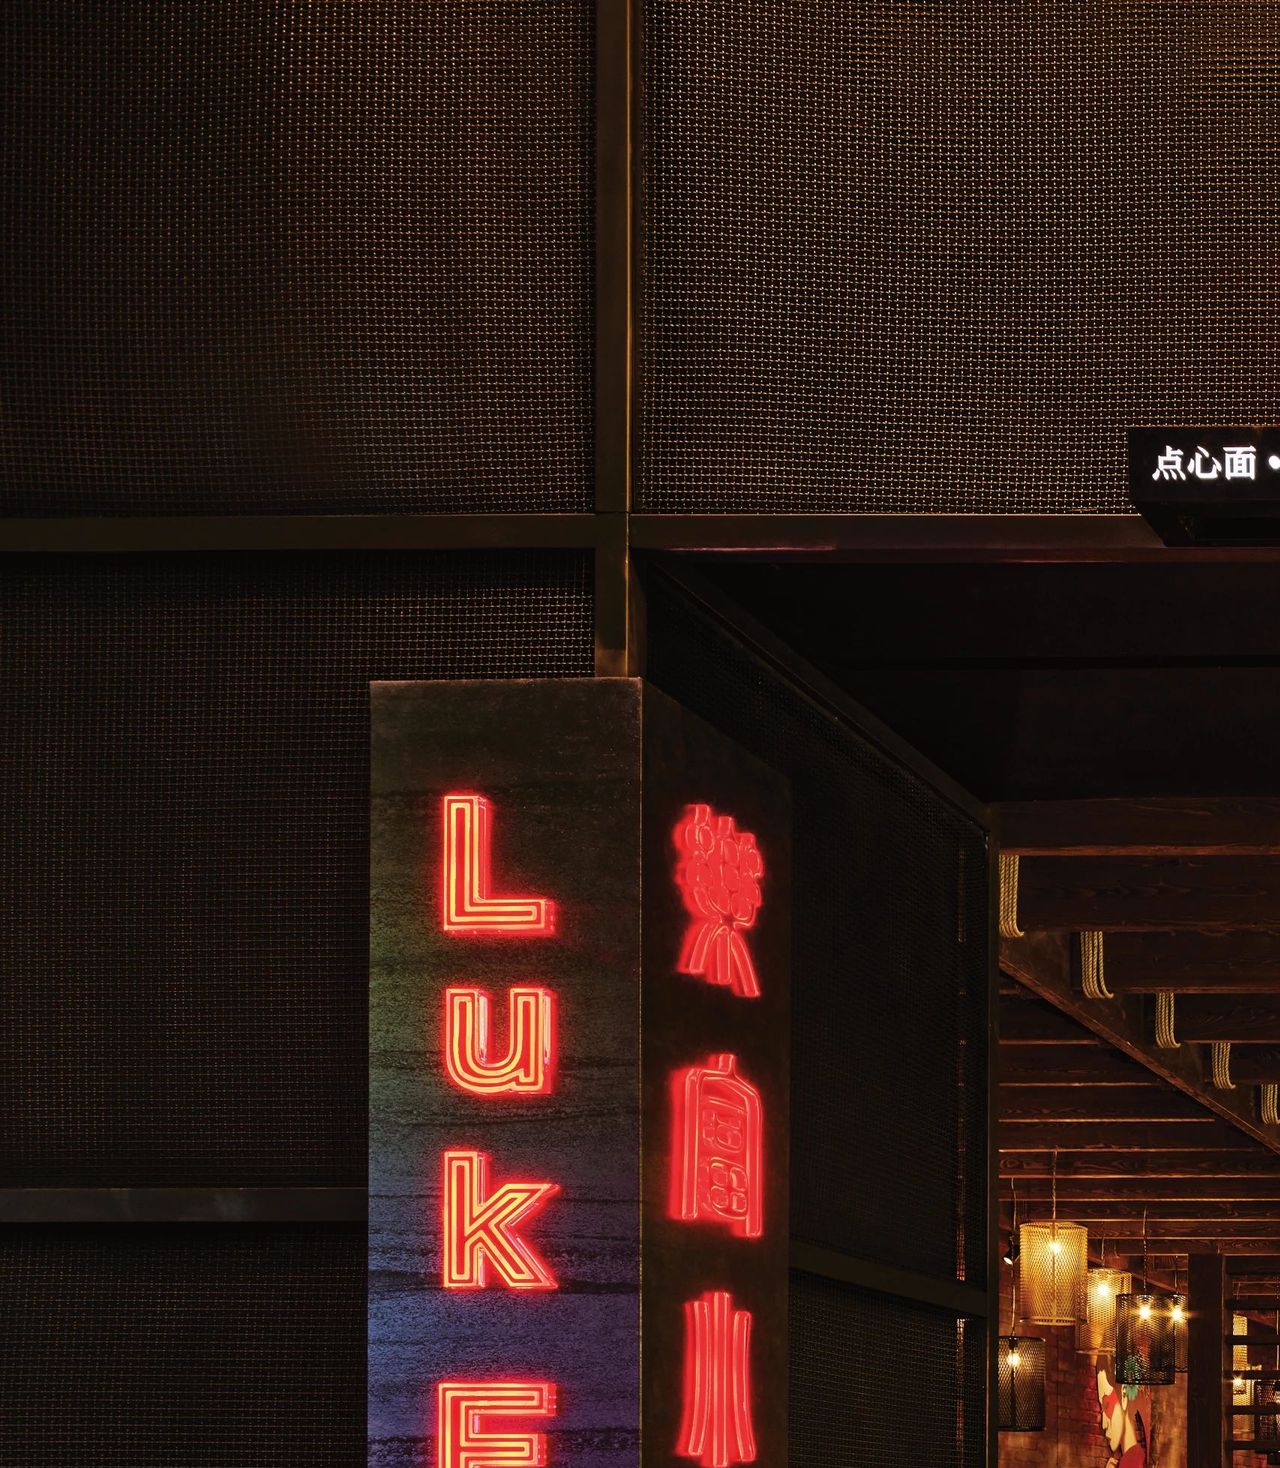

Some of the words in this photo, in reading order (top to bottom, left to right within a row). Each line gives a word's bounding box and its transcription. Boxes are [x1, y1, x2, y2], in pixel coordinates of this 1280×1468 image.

[1152, 446, 1257, 481] 点心面
[442, 794, 560, 1290] Luk
